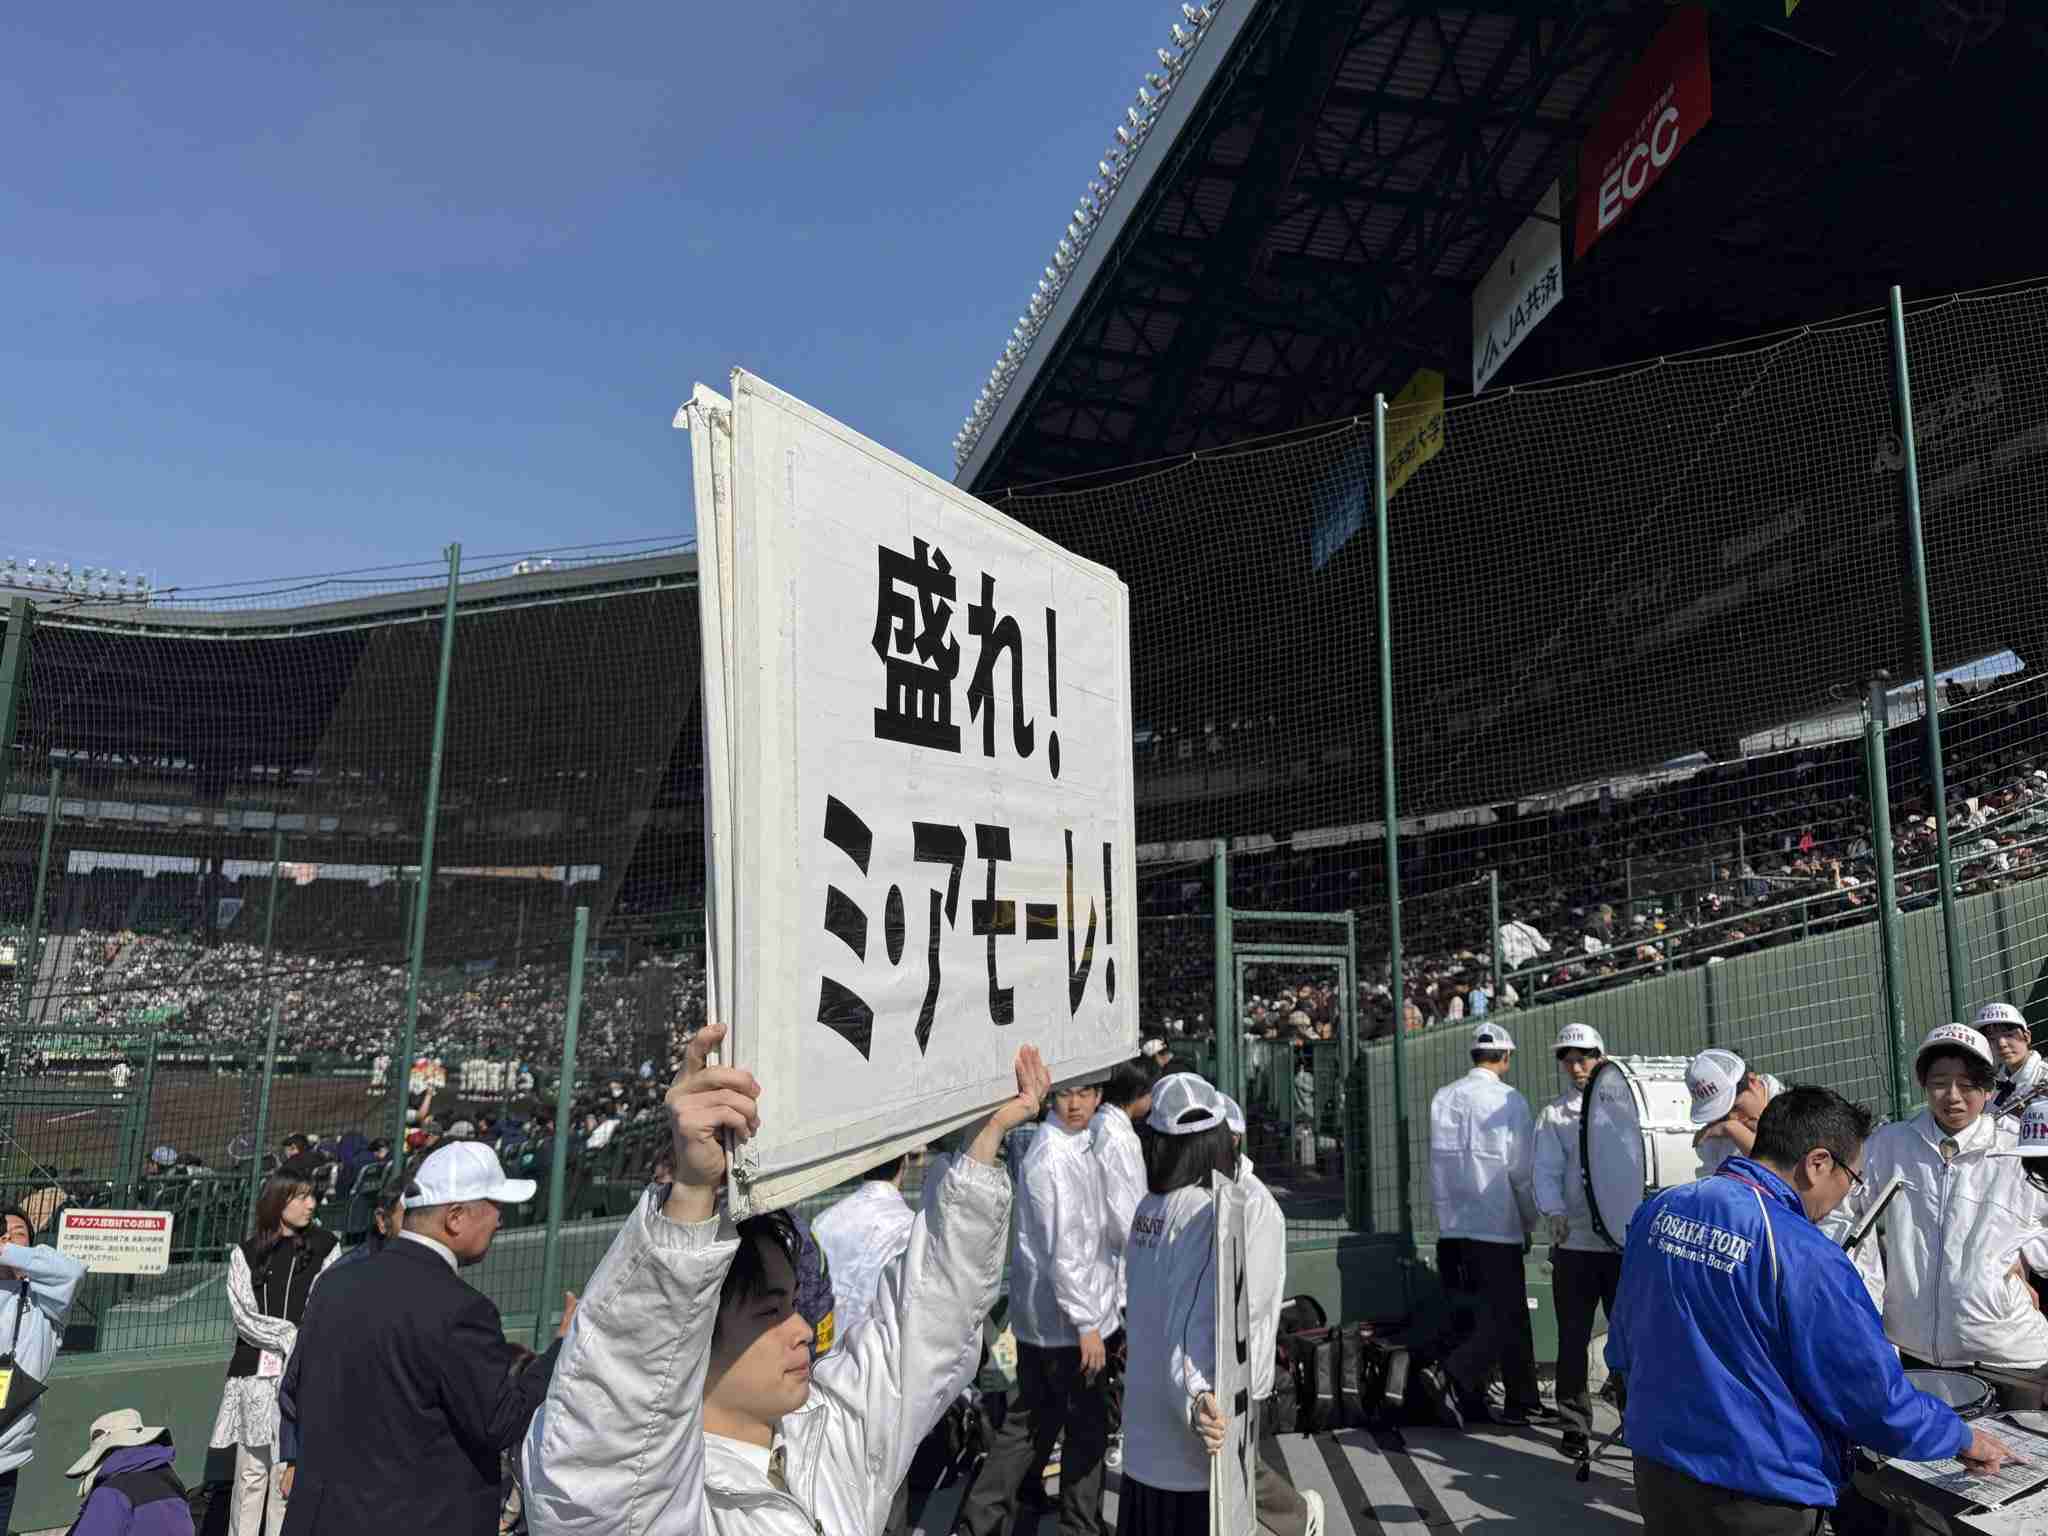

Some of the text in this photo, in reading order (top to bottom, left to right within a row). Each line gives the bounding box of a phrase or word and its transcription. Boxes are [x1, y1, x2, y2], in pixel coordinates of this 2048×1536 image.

[1597, 107, 1680, 231] ECC
[1503, 265, 1559, 348] JA共済
[871, 535, 1063, 780] 盛れ!
[1657, 1237, 1738, 1275] Symphonic Band
[1661, 1213, 1753, 1262] OSAKA TOIN
